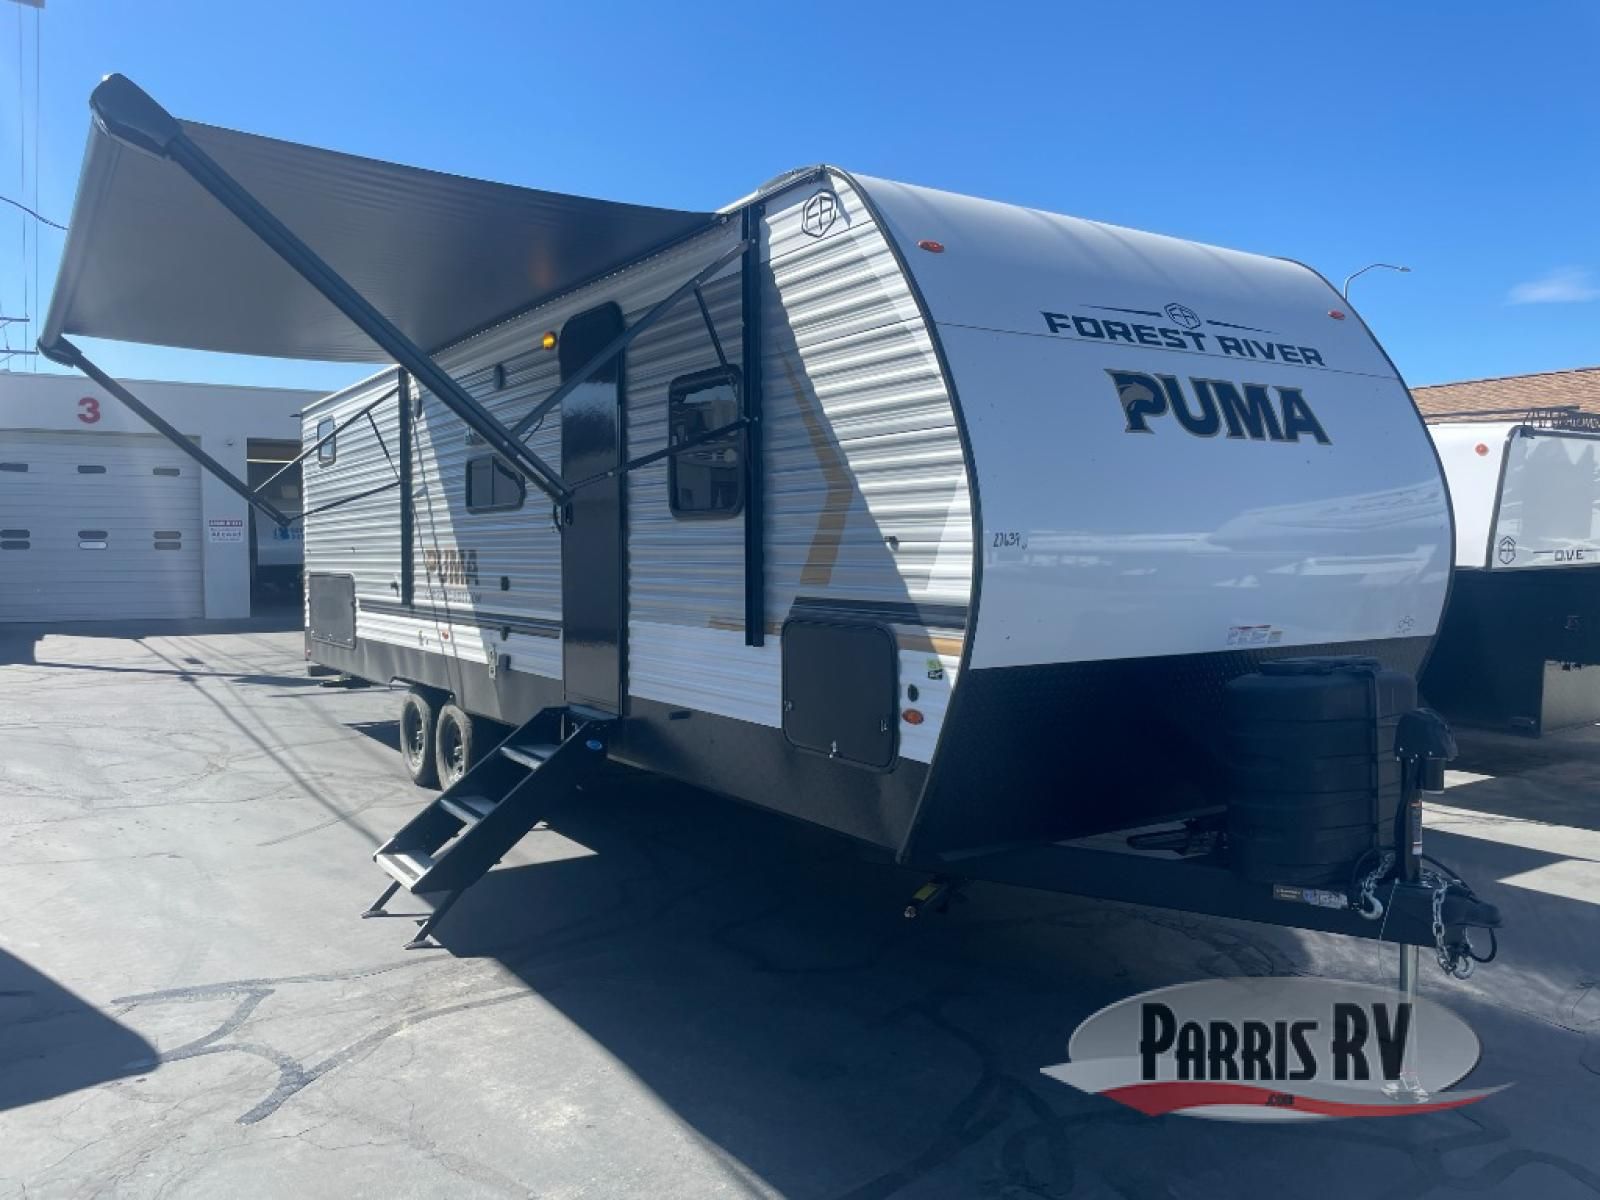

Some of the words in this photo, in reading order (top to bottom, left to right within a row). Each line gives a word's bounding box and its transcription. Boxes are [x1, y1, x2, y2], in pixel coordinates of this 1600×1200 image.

[1040, 311, 1205, 351] FOREST
[1215, 335, 1326, 367] RIVER
[77, 397, 101, 424] 3
[1104, 368, 1333, 446] PUMA
[424, 549, 479, 587] PUMA
